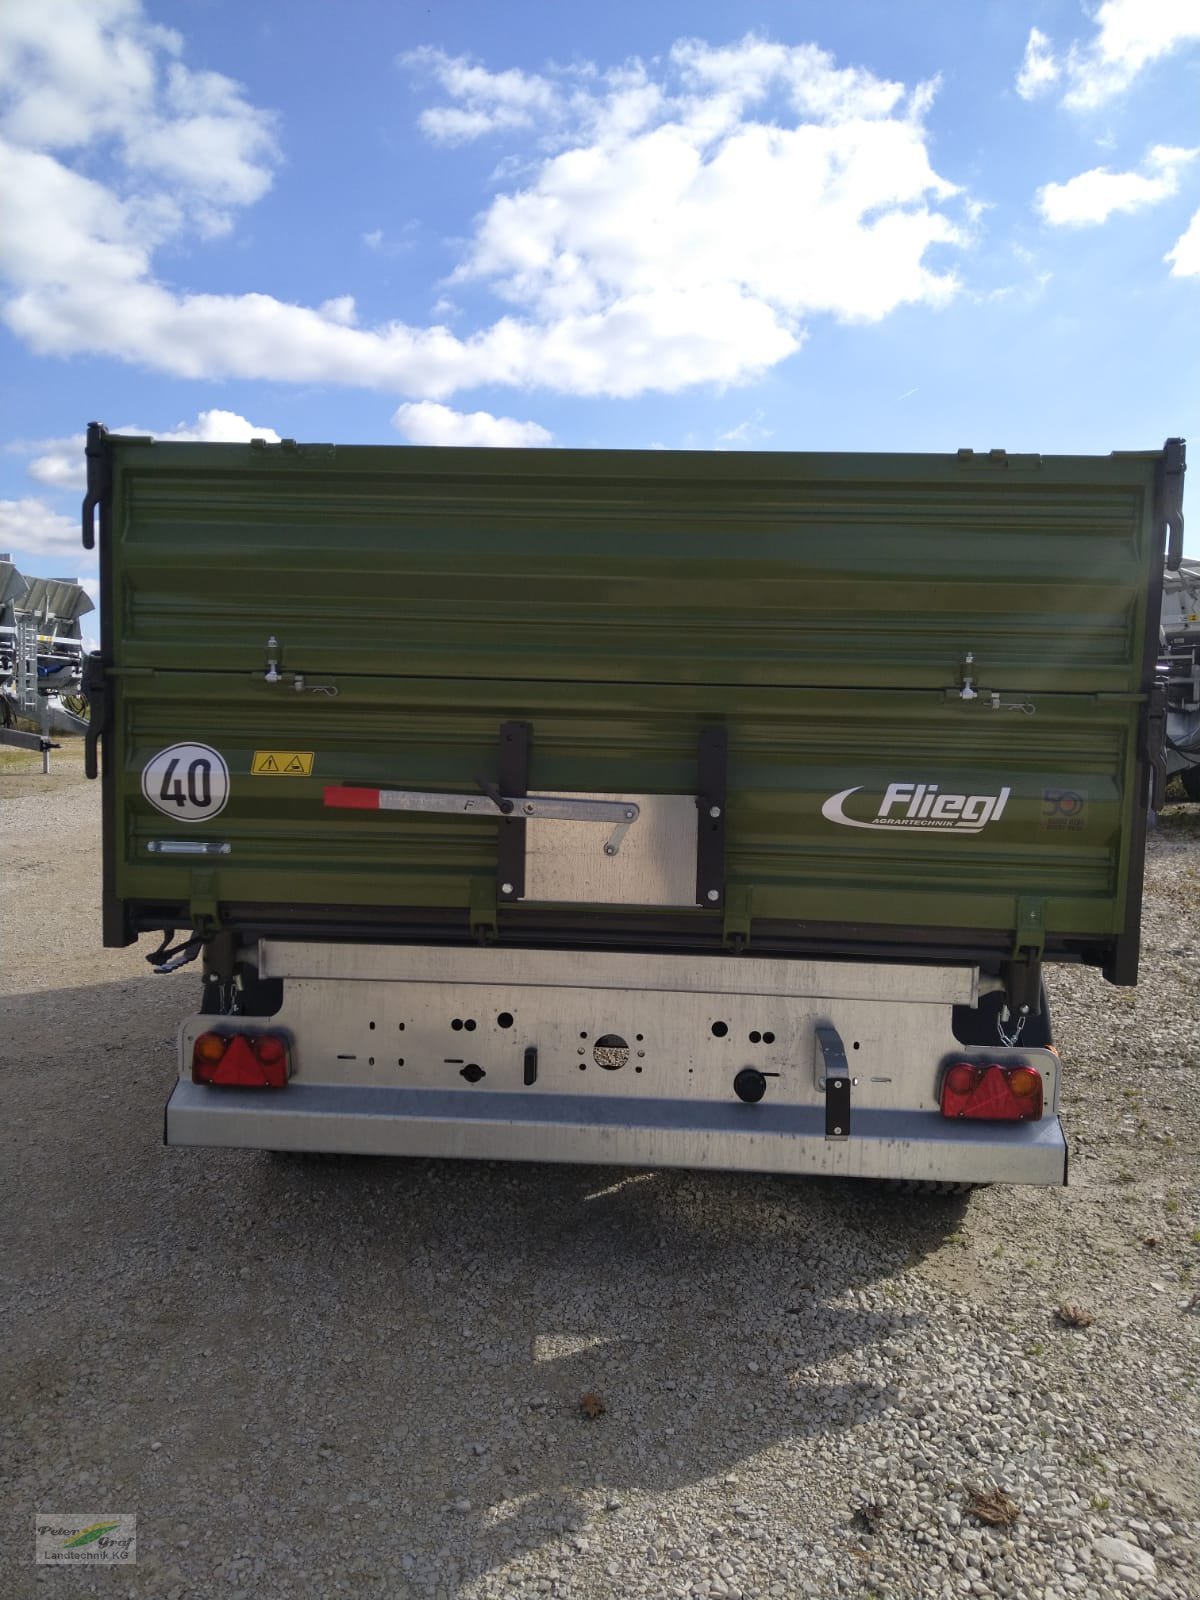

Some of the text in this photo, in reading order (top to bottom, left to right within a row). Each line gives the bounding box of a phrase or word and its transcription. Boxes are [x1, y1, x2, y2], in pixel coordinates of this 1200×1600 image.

[160, 758, 212, 808] 40
[877, 783, 1011, 827] Fliegl
[872, 818, 954, 827] AGRARTECHNIK
